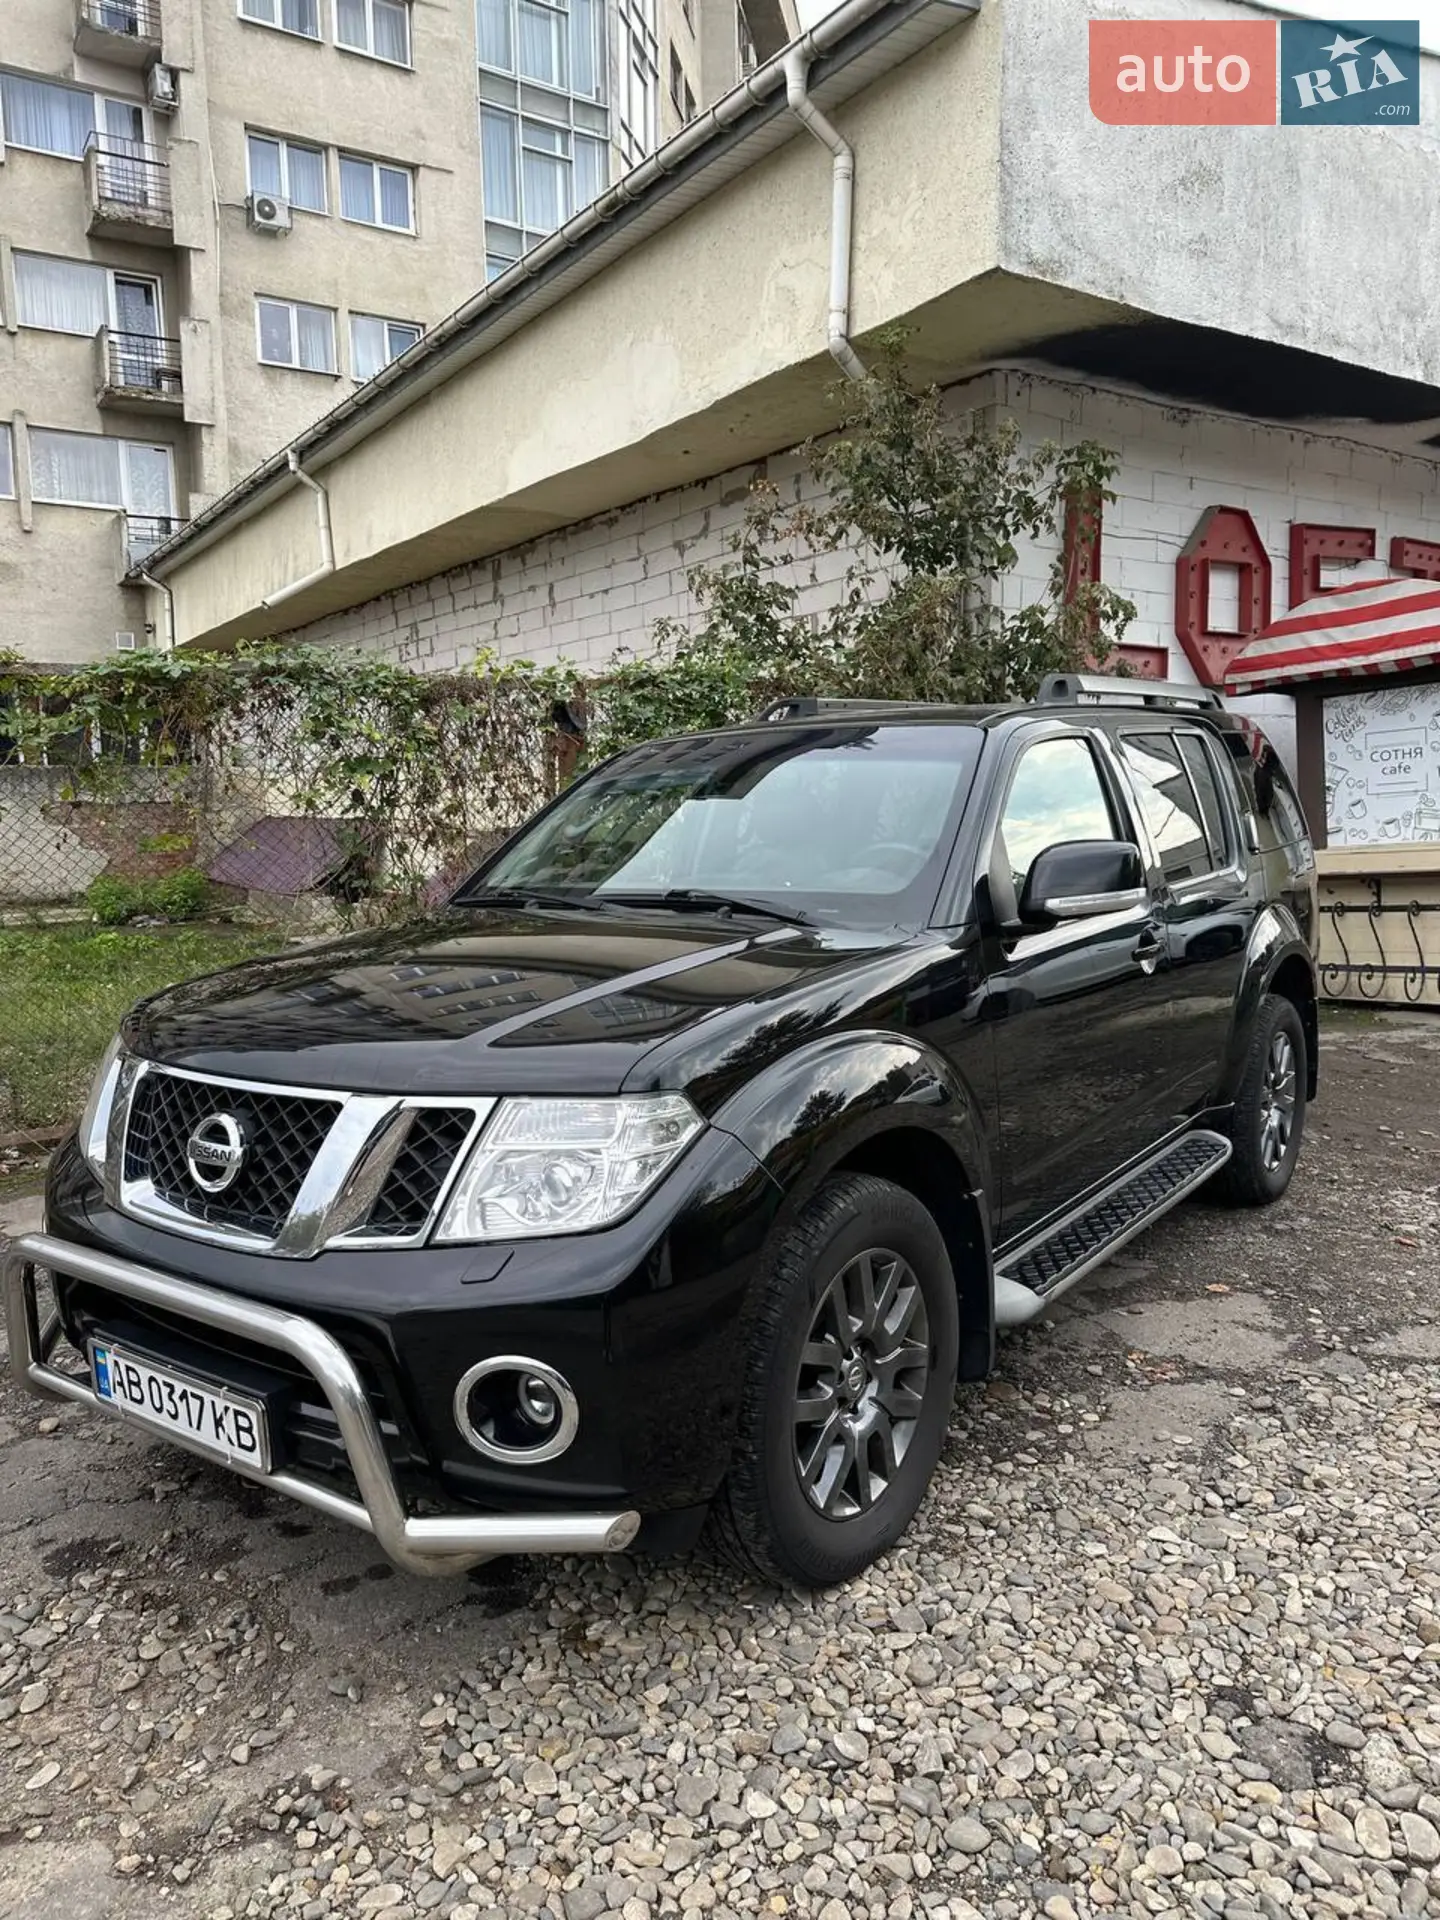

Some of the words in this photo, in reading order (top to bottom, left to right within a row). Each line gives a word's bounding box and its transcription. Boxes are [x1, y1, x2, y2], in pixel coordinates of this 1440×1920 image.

[1369, 746, 1424, 763] СОТНЯ
[1381, 762, 1411, 775] cafe
[112, 1359, 145, 1405] AB
[147, 1375, 205, 1431] 0317
[211, 1400, 257, 1453] KB
